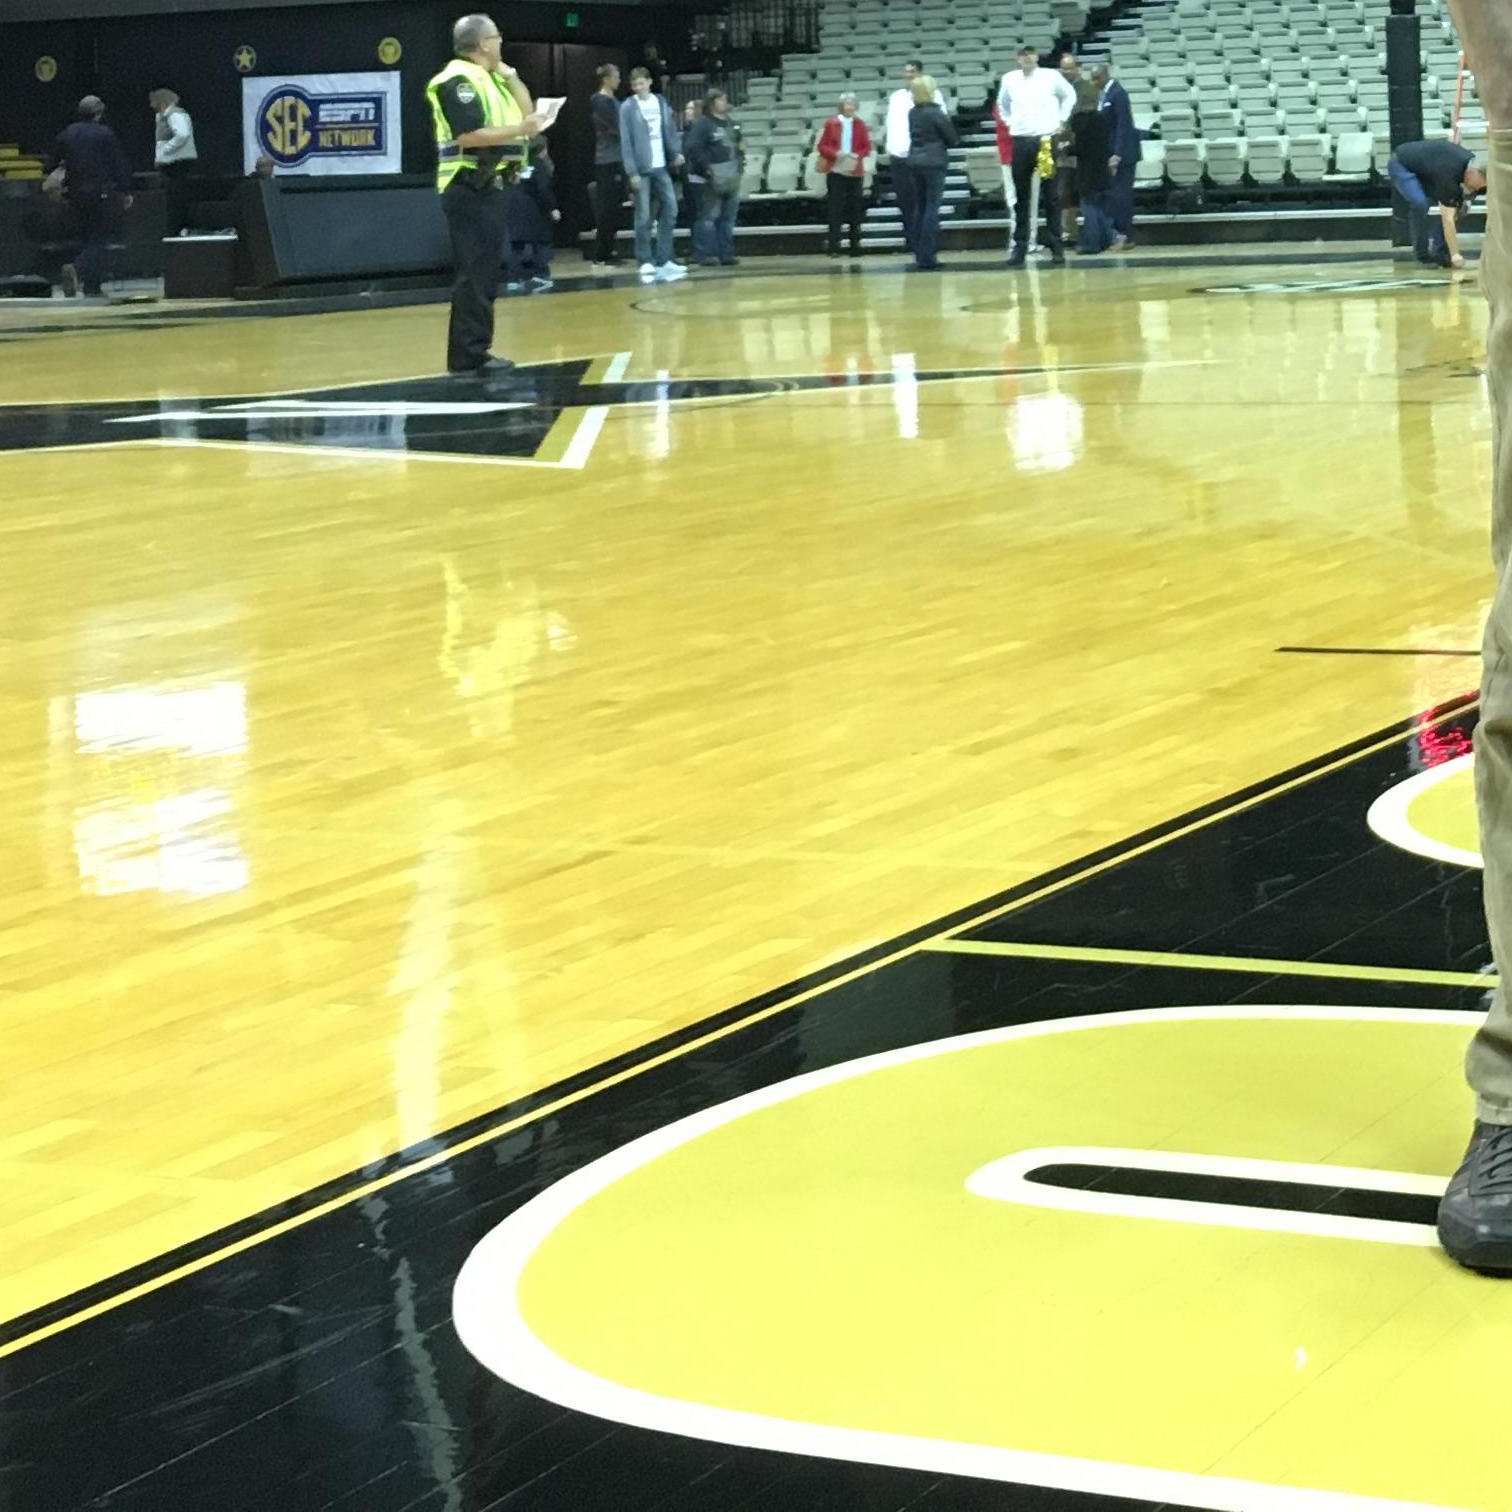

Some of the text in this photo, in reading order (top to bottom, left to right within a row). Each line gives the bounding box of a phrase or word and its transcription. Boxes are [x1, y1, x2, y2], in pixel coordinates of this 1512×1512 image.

[319, 102, 375, 123] ESPN
[266, 96, 312, 155] SEC
[319, 129, 376, 147] NETWORK
